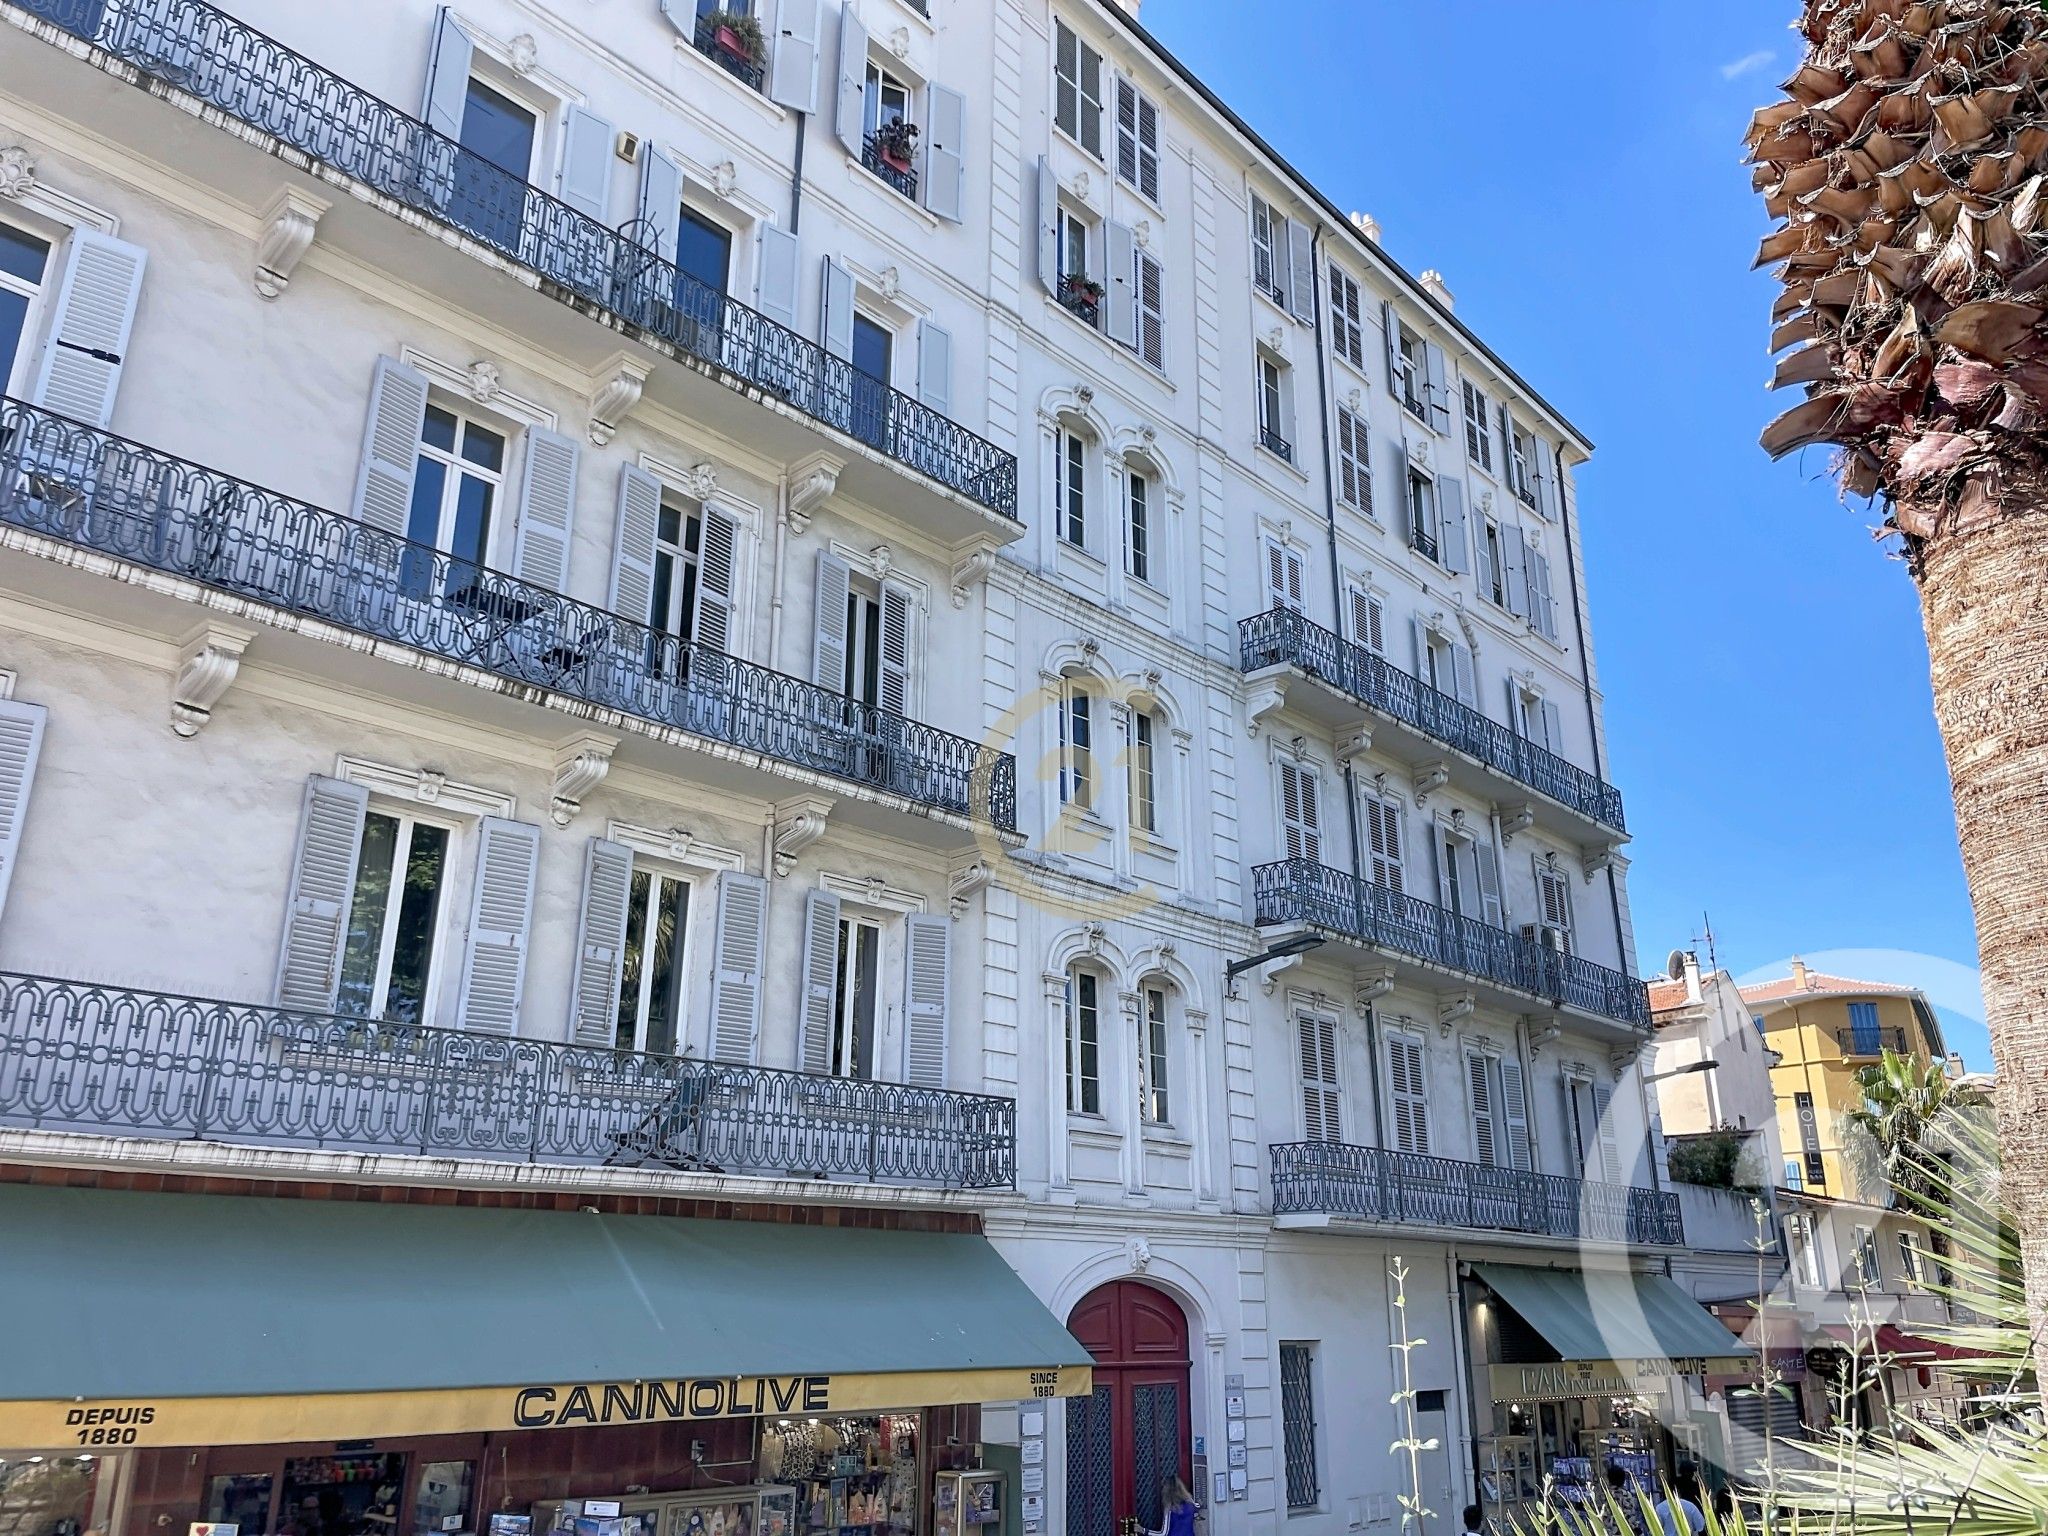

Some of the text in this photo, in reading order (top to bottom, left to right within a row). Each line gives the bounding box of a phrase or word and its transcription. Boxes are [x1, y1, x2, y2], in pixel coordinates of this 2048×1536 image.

[1798, 1095, 1819, 1165] HOTEL
[1636, 1358, 1708, 1377] CANNOLIVE
[1030, 1372, 1058, 1385] SINCE
[1033, 1385, 1055, 1398] 1880
[514, 1376, 830, 1427] CANNOLIVE
[66, 1407, 156, 1426] DEPUIS
[76, 1427, 138, 1446] 1880
